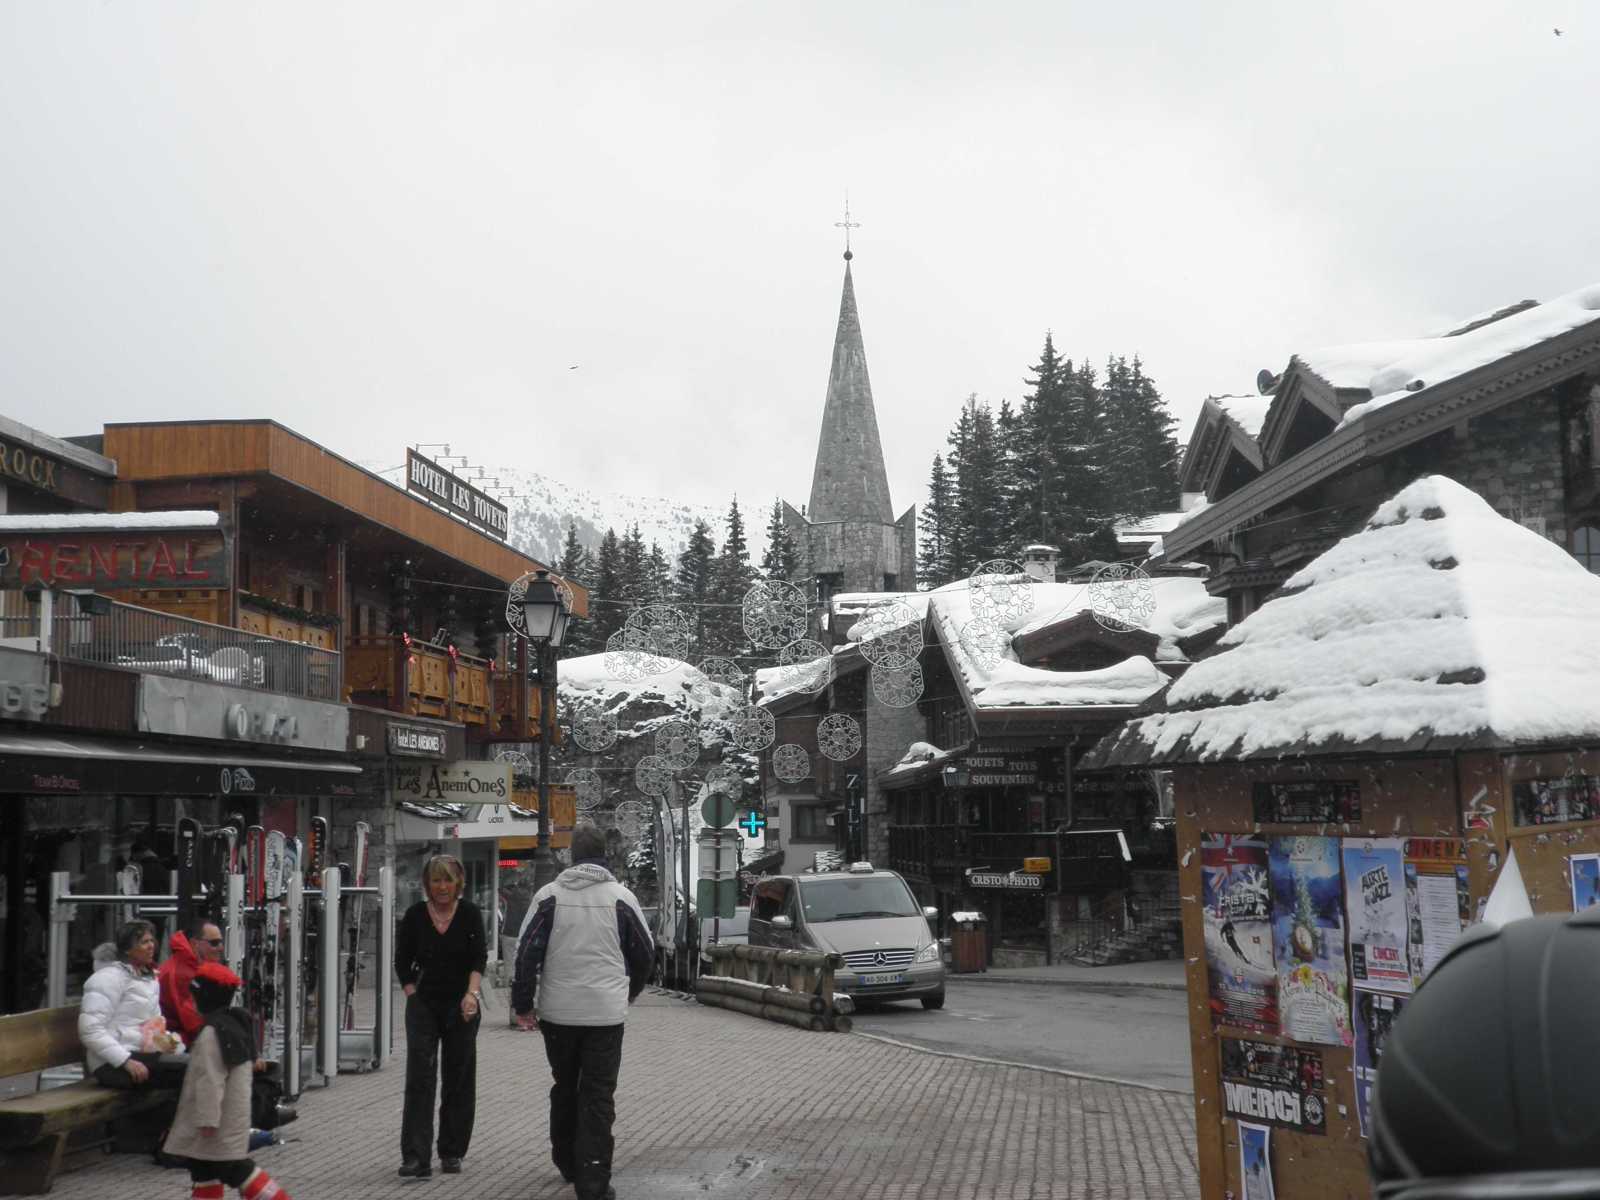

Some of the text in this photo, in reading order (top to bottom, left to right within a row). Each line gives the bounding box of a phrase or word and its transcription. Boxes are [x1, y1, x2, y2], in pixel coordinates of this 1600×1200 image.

[411, 457, 507, 534] HOTEL LES TOVETS
[19, 539, 209, 582] RENTAL
[1008, 761, 1039, 772] TOYS
[972, 774, 1036, 785] SOUVENIRS
[971, 874, 1040, 887] CRISTO PHOTO
